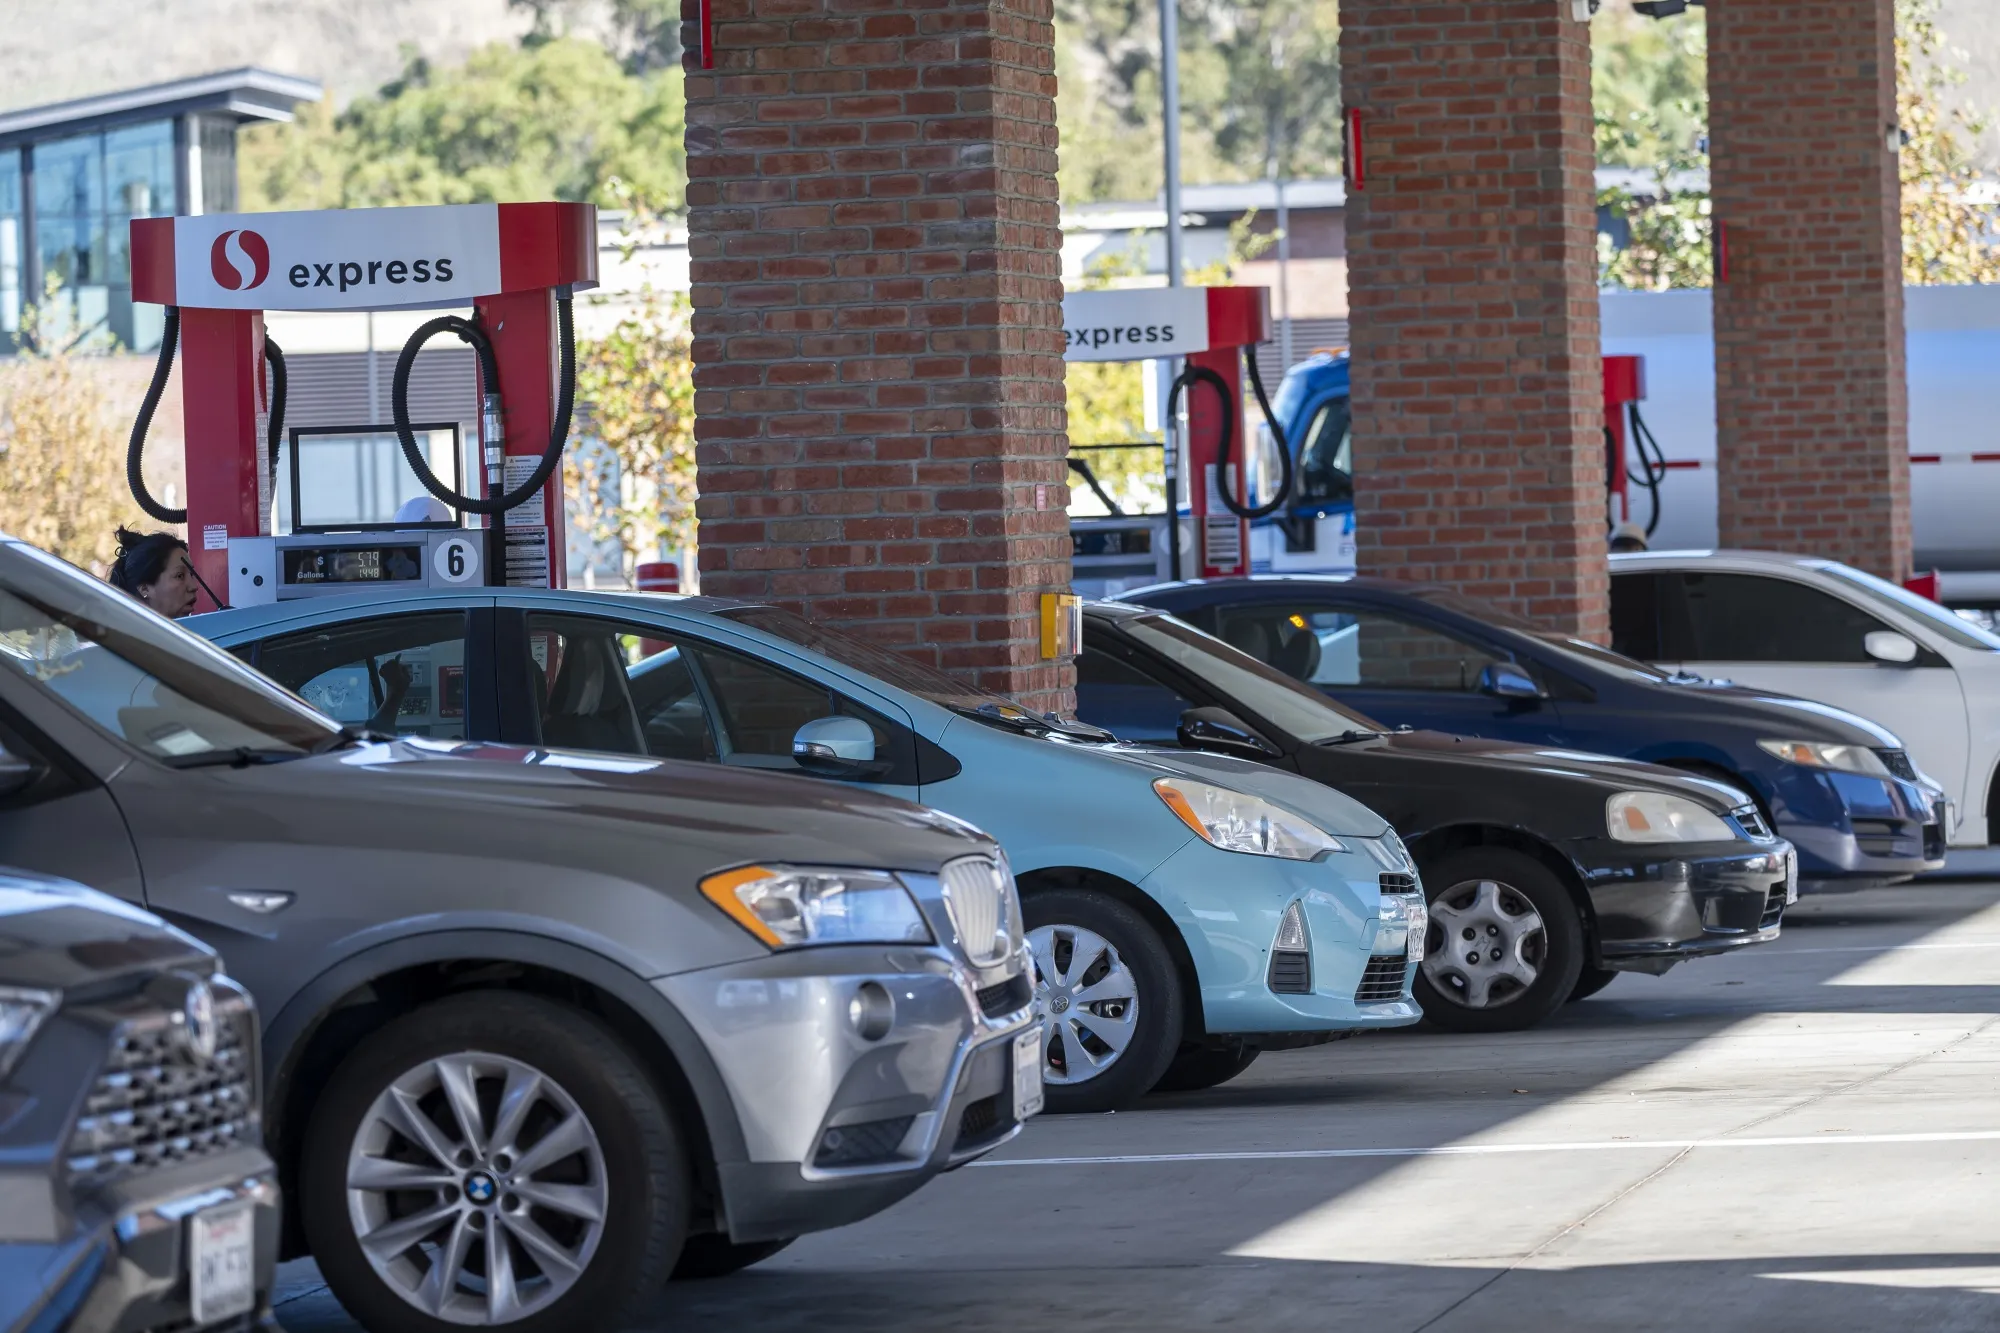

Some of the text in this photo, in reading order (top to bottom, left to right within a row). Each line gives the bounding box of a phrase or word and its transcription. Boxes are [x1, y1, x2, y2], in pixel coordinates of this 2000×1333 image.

[288, 258, 454, 293] express
[203, 523, 227, 531] CAUTION
[357, 551, 380, 567] 5.79
[448, 544, 465, 577] 6
[297, 571, 325, 579] Gallons
